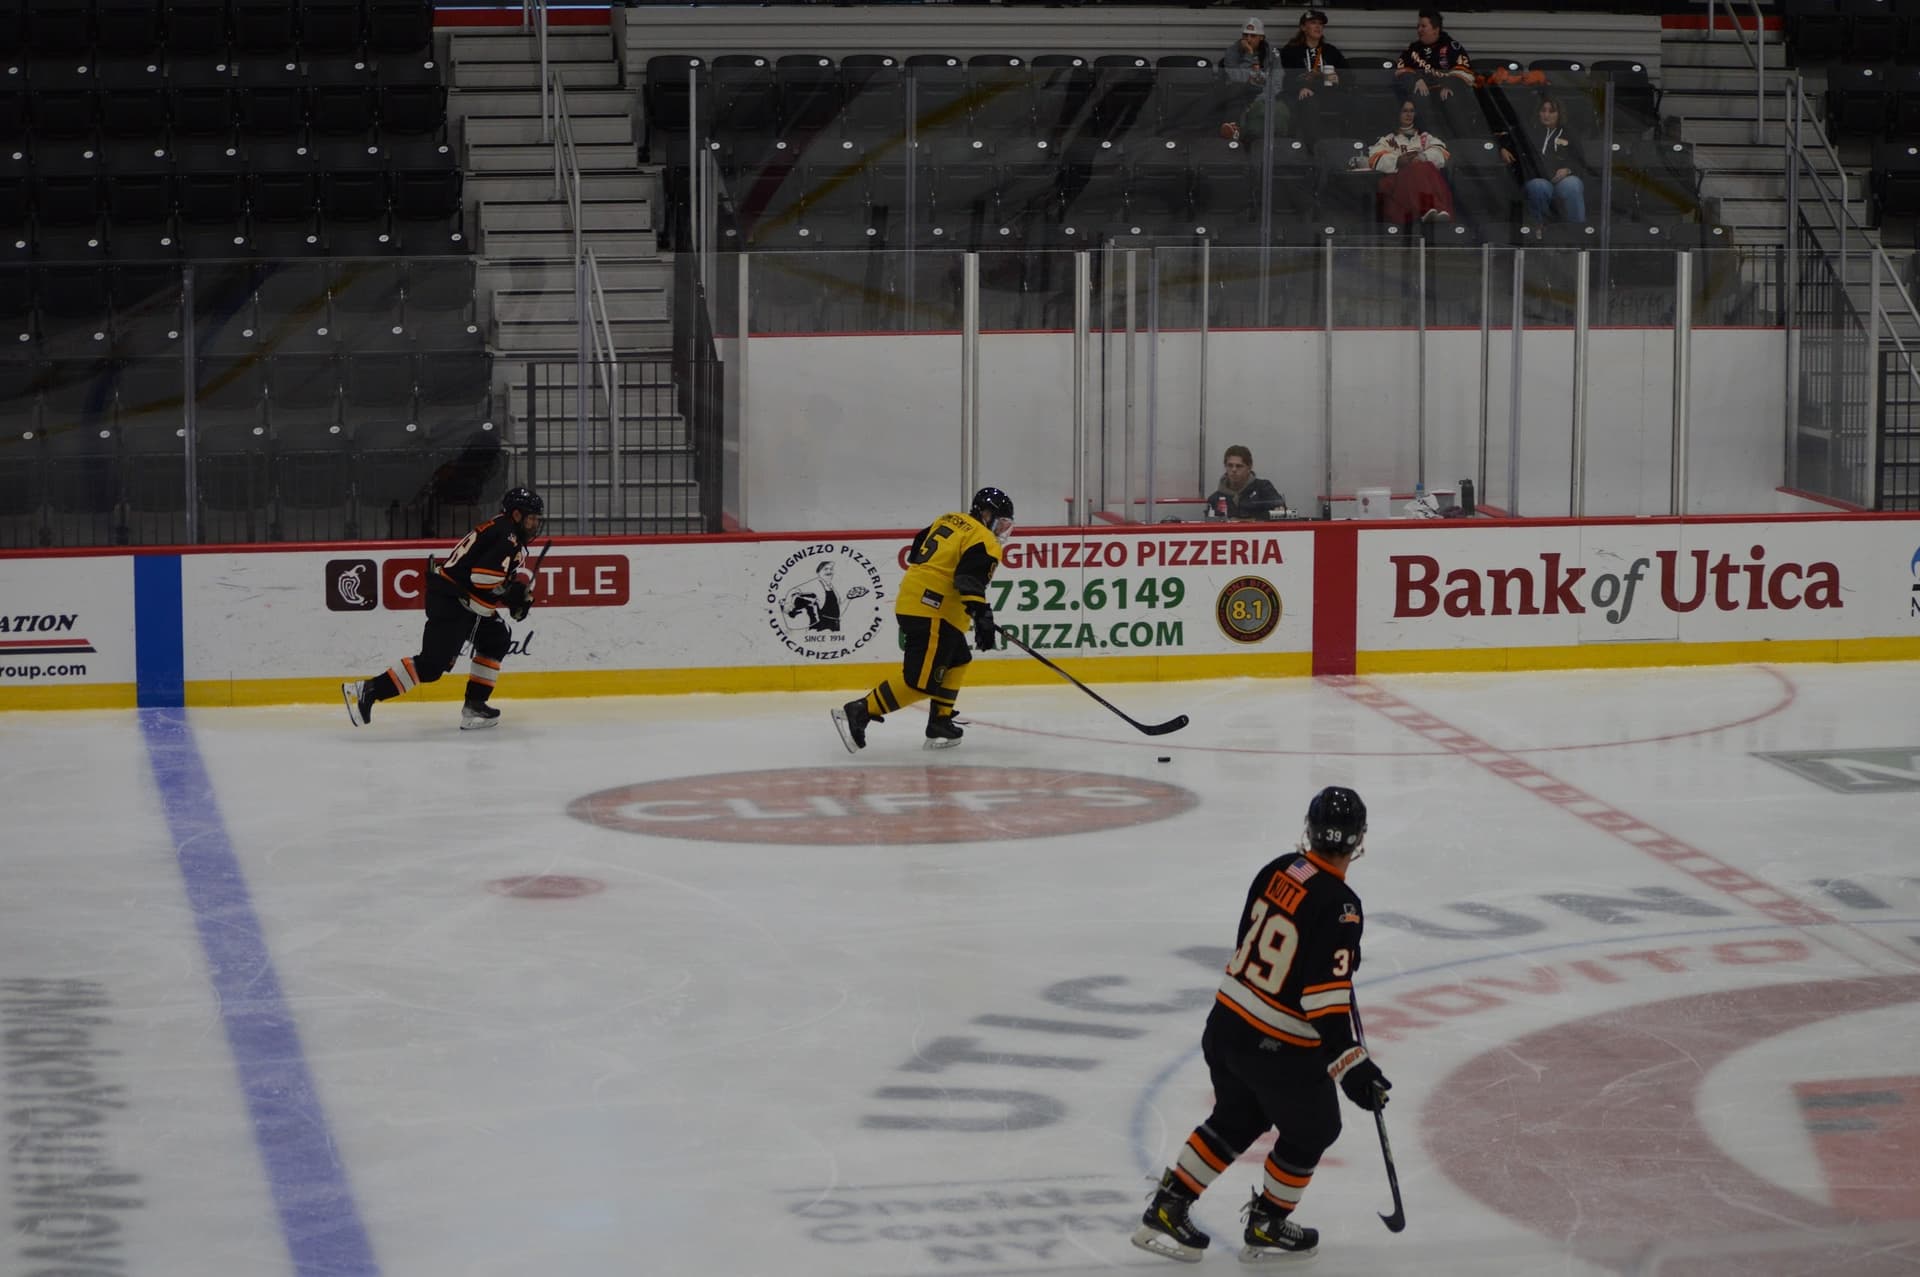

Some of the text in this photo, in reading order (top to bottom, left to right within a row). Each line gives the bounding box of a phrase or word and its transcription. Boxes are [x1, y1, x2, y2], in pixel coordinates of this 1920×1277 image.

[896, 538, 1283, 570] GNIZZO PIZZERIA
[393, 565, 617, 600] COTLE
[767, 544, 885, 603] O'SCUGNIZZO PIZZERIA
[1390, 544, 1844, 625] Bank of Utica
[990, 576, 1185, 613] 732.6149
[1232, 599, 1263, 620] 8.1
[0, 614, 78, 632] ATION
[769, 617, 883, 660] UTICAPIZZA.COM
[830, 634, 845, 642] 1914
[616, 785, 1152, 822] CLIFF'S
[1326, 828, 1343, 843] 39
[1363, 877, 1920, 942] UNI
[1226, 896, 1300, 996] 39
[1332, 947, 1354, 977] 3
